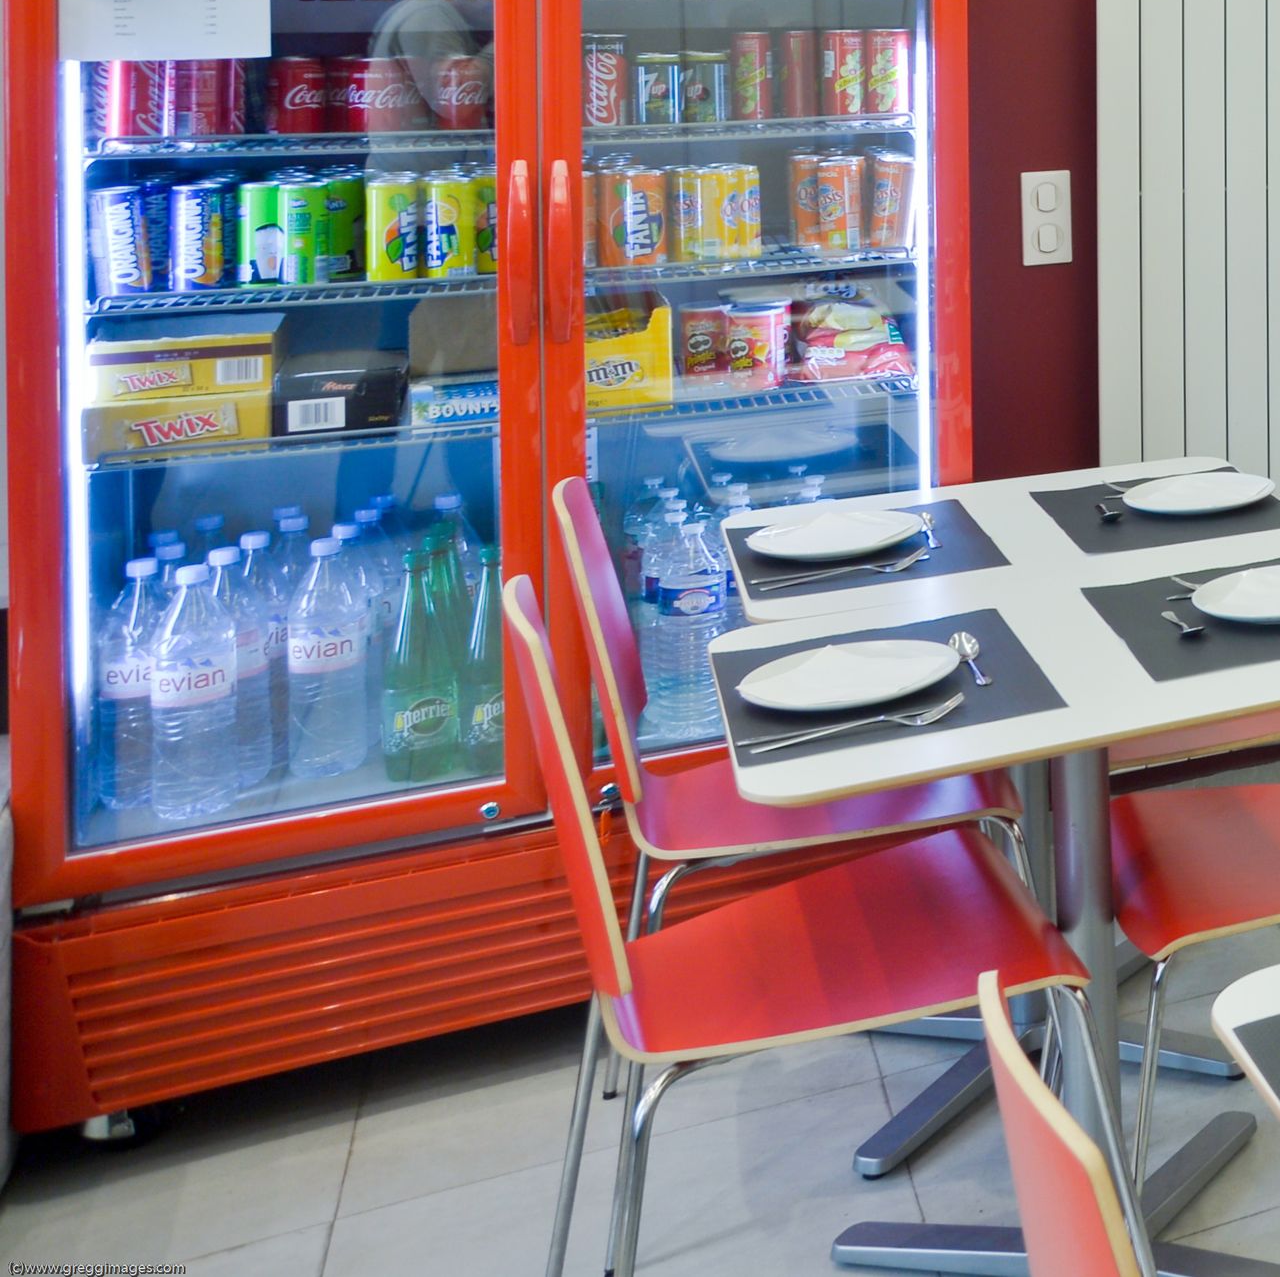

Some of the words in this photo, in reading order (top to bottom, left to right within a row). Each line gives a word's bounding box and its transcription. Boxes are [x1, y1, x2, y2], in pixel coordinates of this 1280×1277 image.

[106, 201, 141, 284] ORANGINA
[176, 198, 206, 280] ORANGINA
[624, 191, 652, 259] FANTA
[131, 412, 220, 447] Twix
[292, 636, 353, 660] evian
[106, 664, 155, 686] evia
[159, 668, 225, 693] evian
